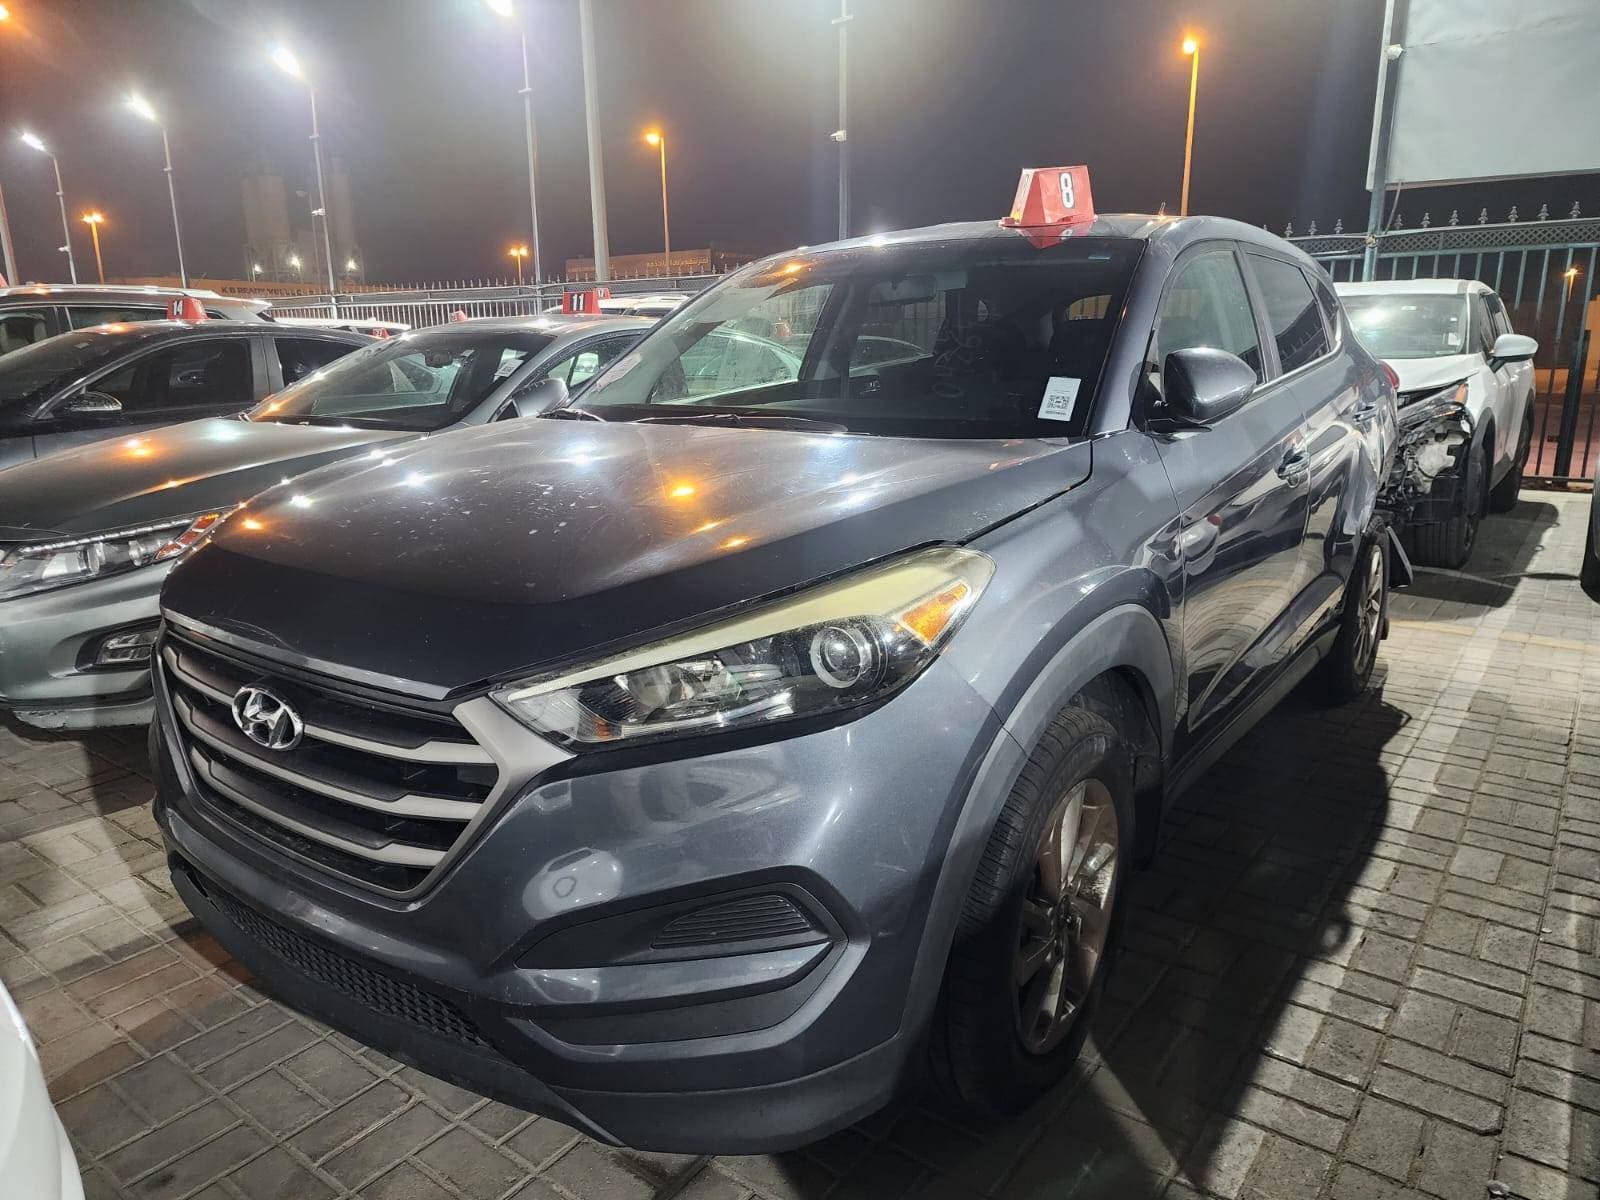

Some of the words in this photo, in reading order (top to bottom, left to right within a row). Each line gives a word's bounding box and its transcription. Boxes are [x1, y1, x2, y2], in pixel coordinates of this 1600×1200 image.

[1059, 172, 1074, 208] 8
[171, 299, 181, 316] 14
[571, 293, 585, 311] 11
